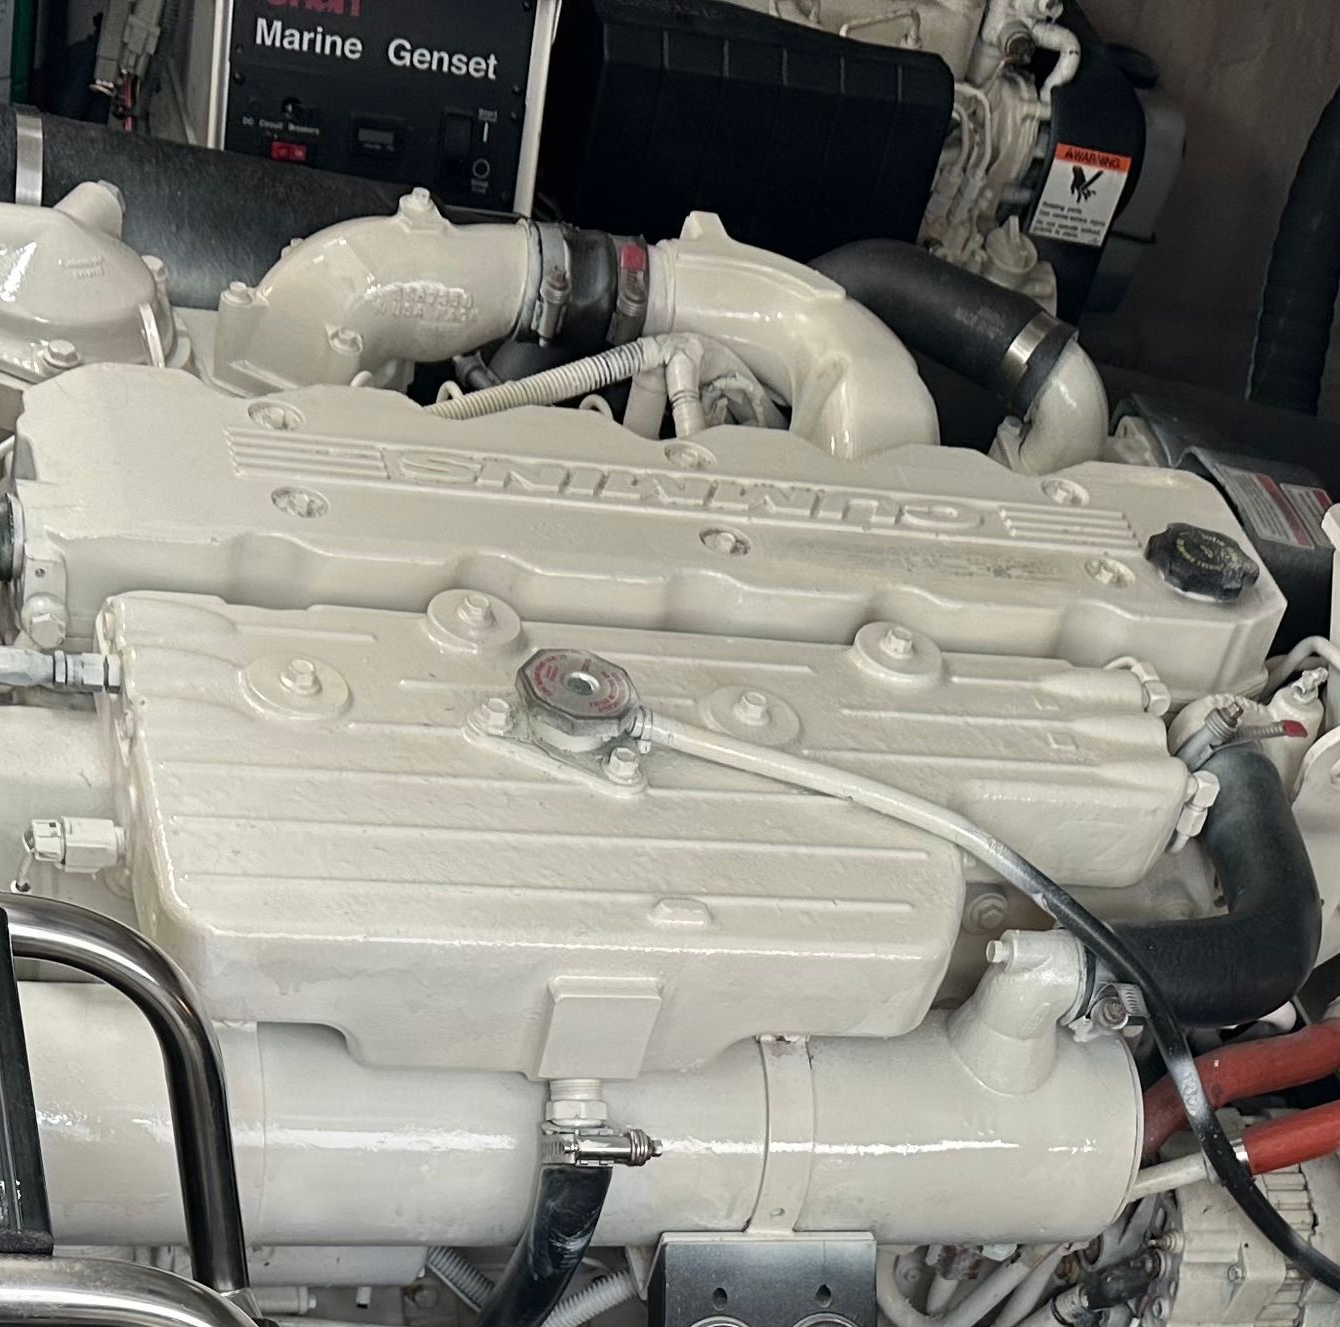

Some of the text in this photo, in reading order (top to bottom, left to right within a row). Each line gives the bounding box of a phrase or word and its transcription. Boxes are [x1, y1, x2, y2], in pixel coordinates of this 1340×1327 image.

[255, 17, 498, 81] Marine Genset
[1071, 149, 1121, 169] WARNING
[391, 451, 983, 528] CUMMINS
